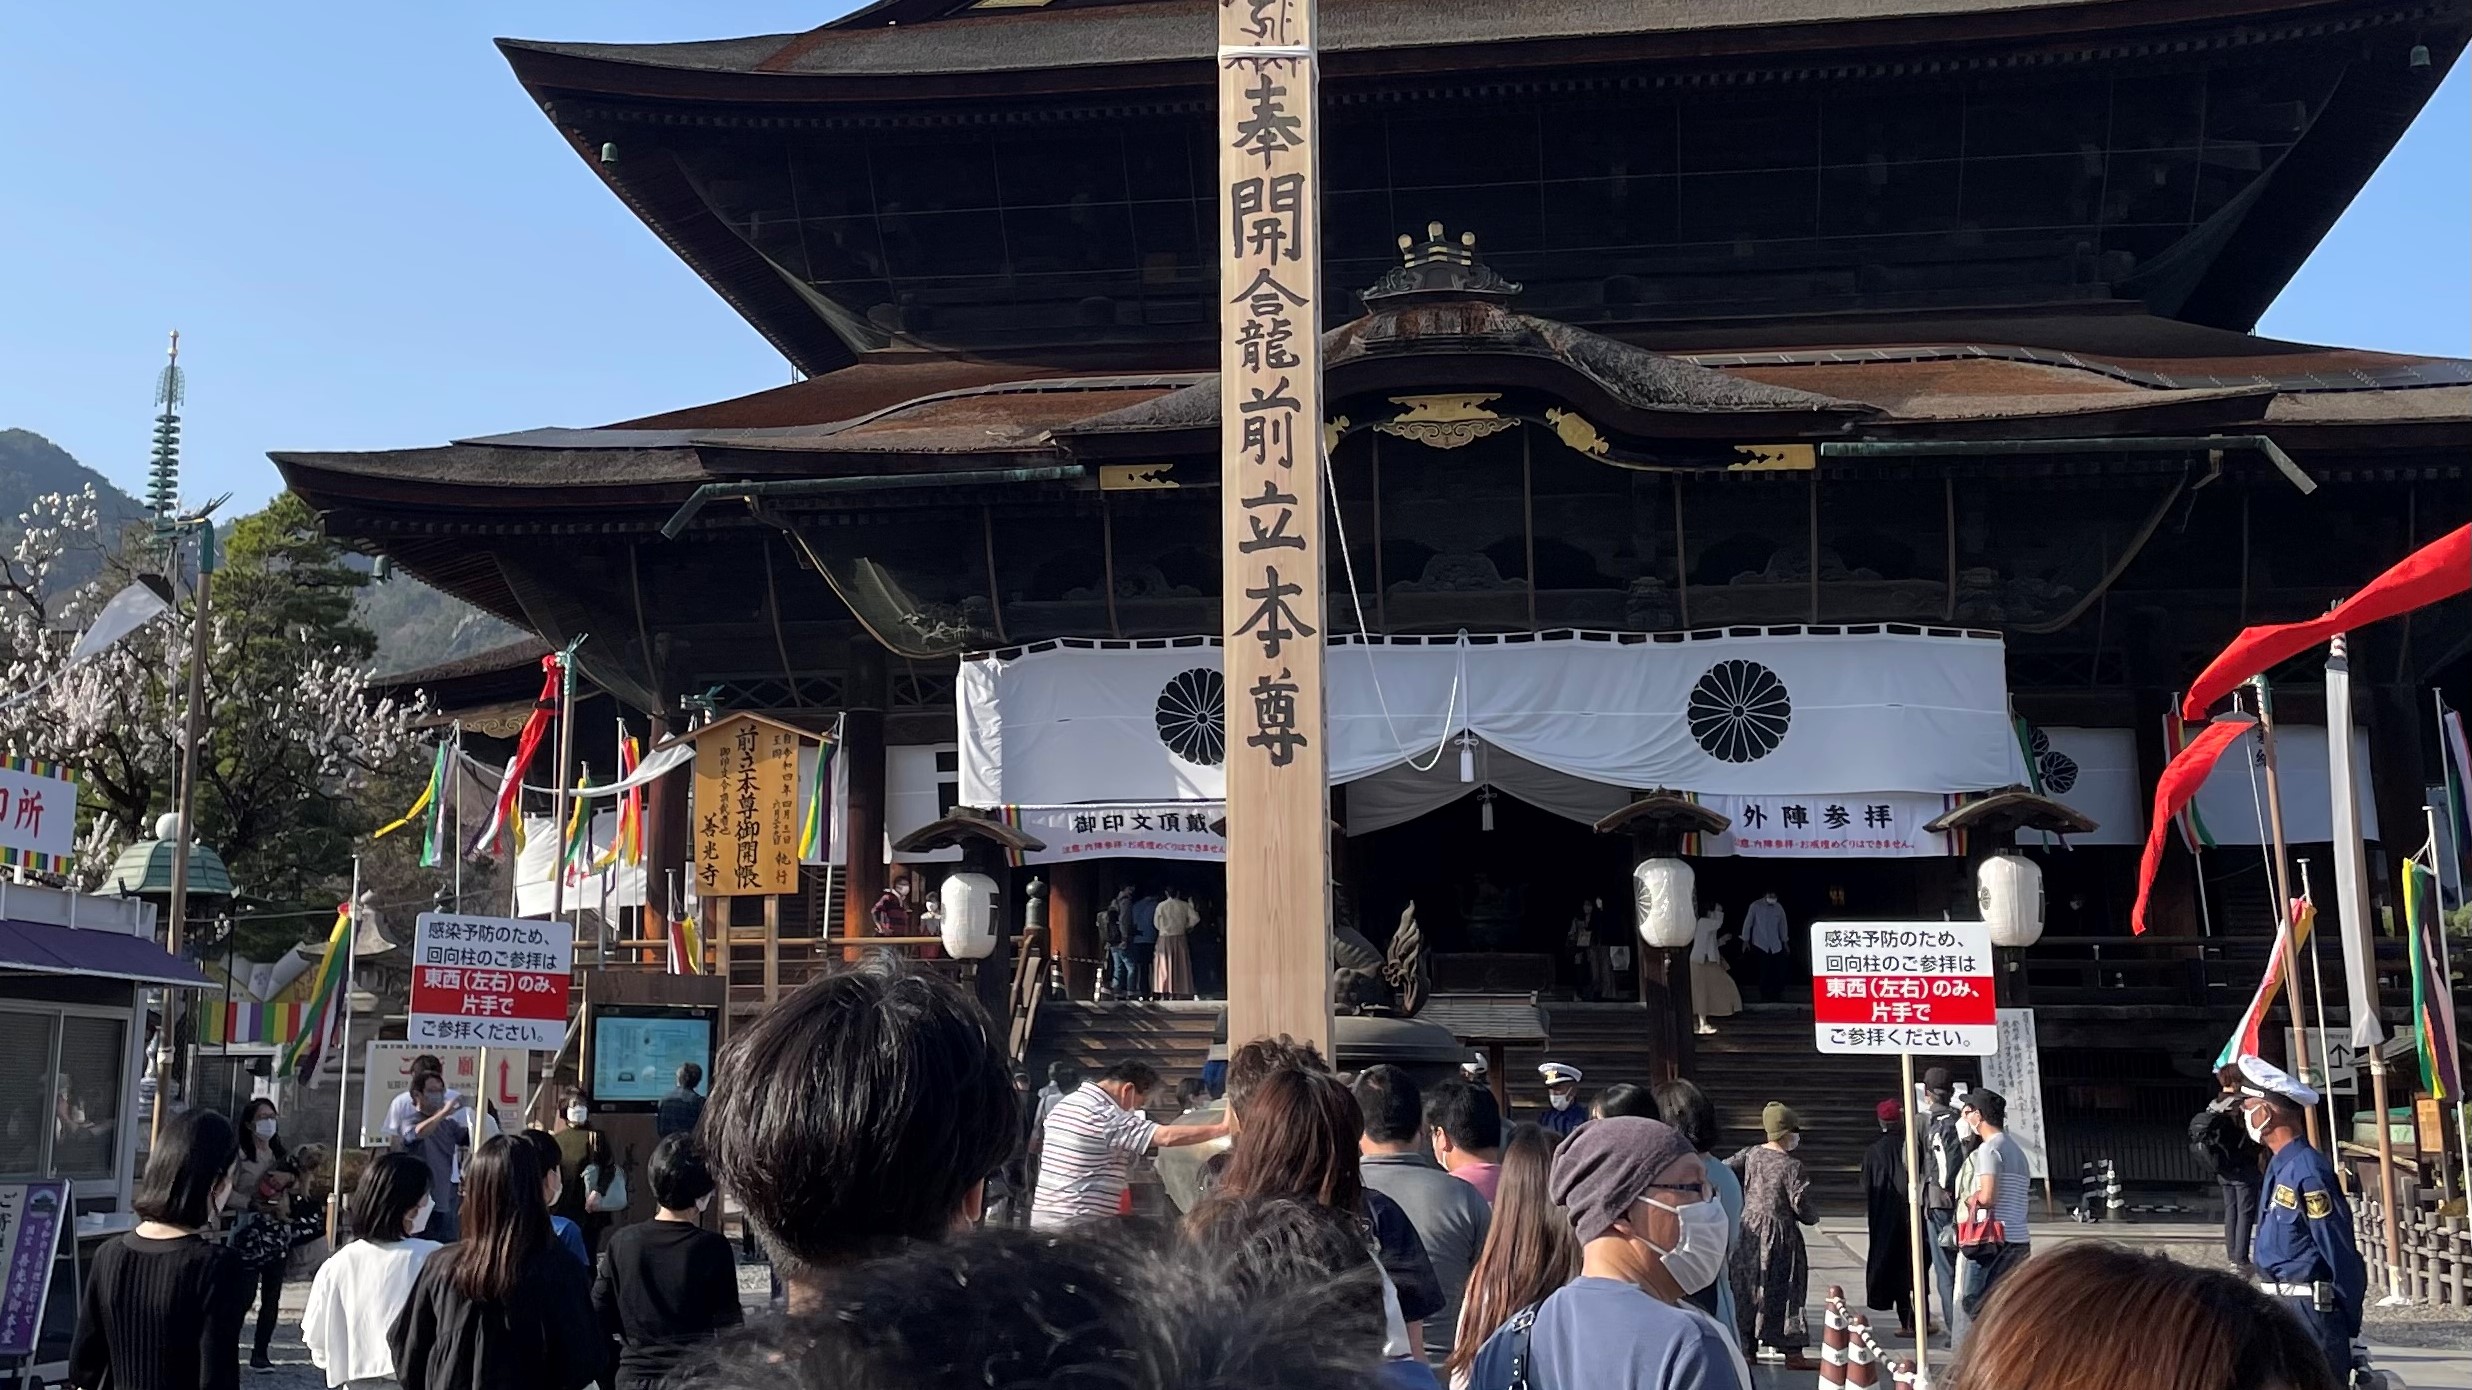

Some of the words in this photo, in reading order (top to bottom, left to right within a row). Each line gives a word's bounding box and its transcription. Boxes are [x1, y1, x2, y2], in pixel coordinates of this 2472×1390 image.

[735, 724, 763, 890] 前立本尊御開帳
[1743, 804, 1893, 830] 外陣参拝
[1074, 813, 1209, 834] 御印文頂戴
[699, 812, 720, 888] 善光寺
[428, 922, 550, 945] 感染予防のため、
[1825, 930, 1965, 948] 感染予防のため、
[427, 946, 557, 970] 回向柱のご参拝は
[1826, 955, 1977, 973] 回向柱のご参拝は
[461, 994, 514, 1016] 片手で
[1871, 1001, 1932, 1023] 片手で
[421, 1020, 543, 1042] ご参拝ください。
[1830, 1028, 1971, 1048] ご参拝ください。
